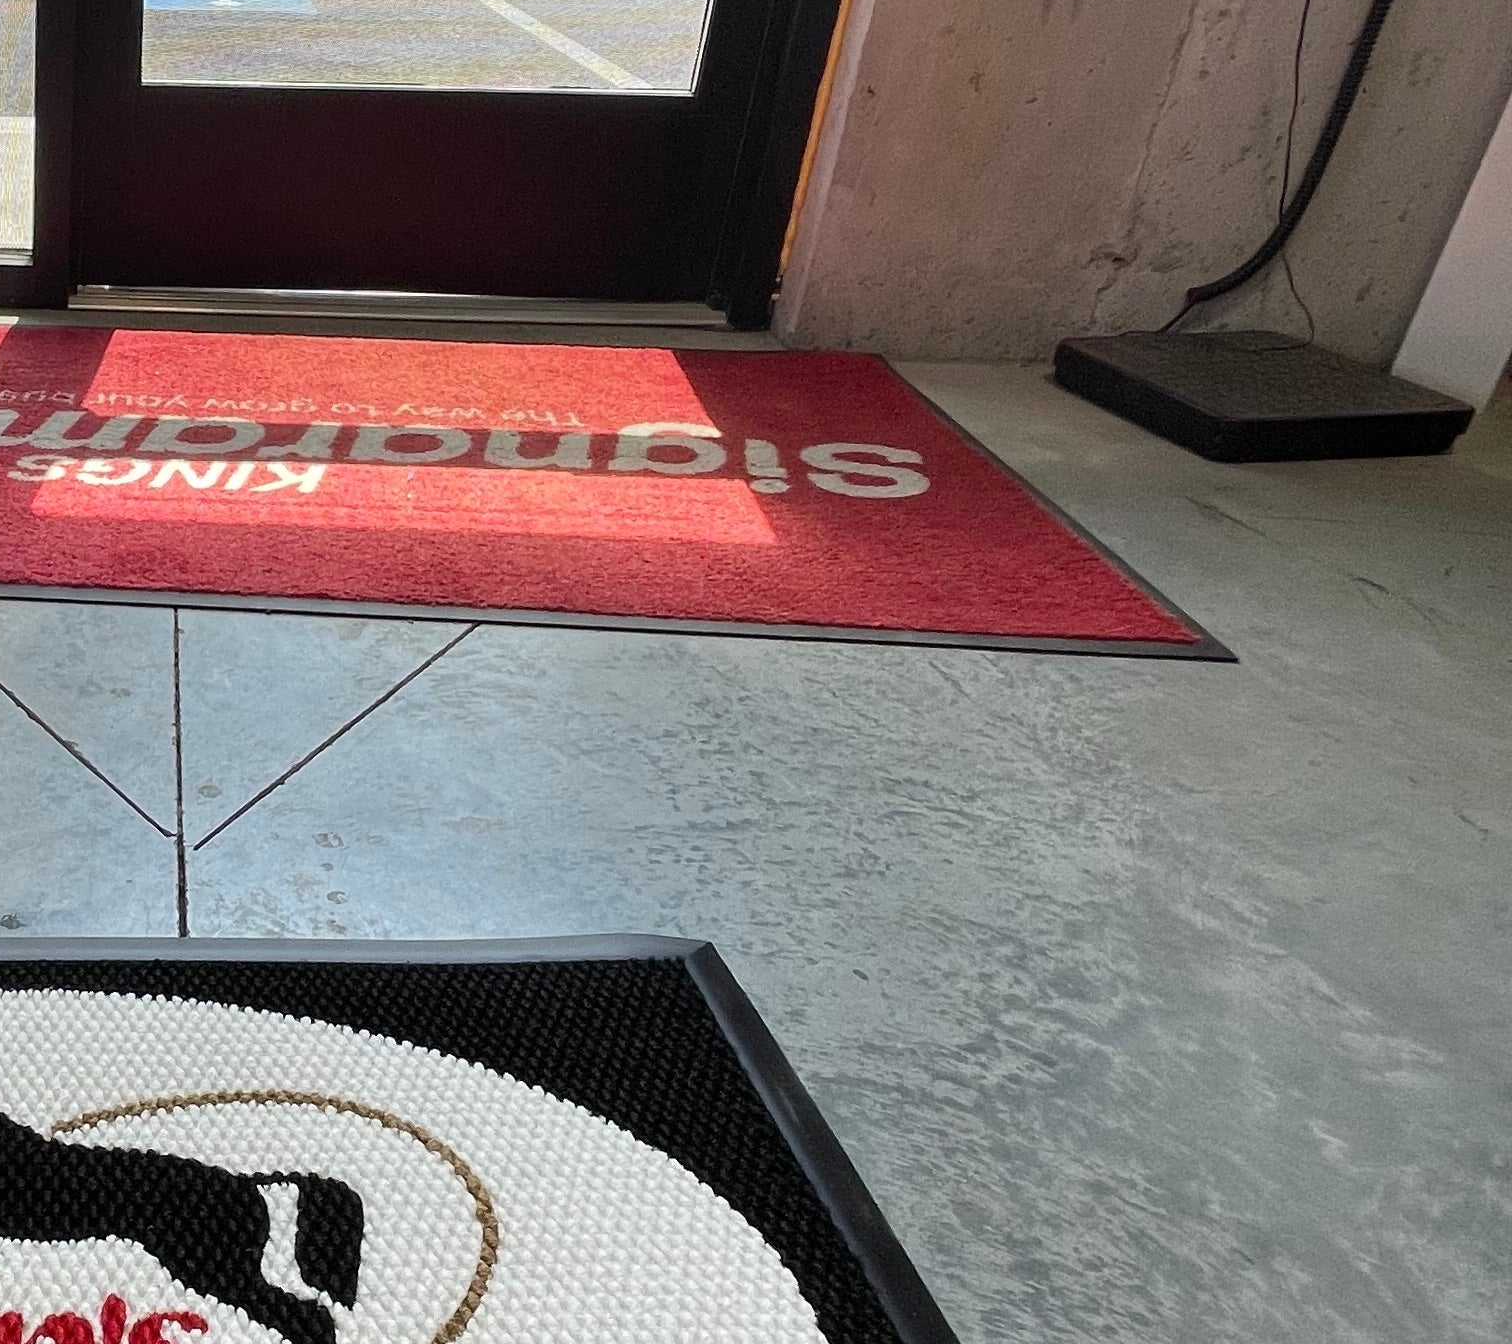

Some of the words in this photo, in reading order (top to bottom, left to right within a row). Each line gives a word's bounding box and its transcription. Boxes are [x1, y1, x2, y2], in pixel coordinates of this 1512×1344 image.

[89, 391, 189, 411] your
[203, 397, 317, 416] grow
[328, 401, 378, 420] to
[396, 402, 486, 422] way
[499, 405, 587, 429] The
